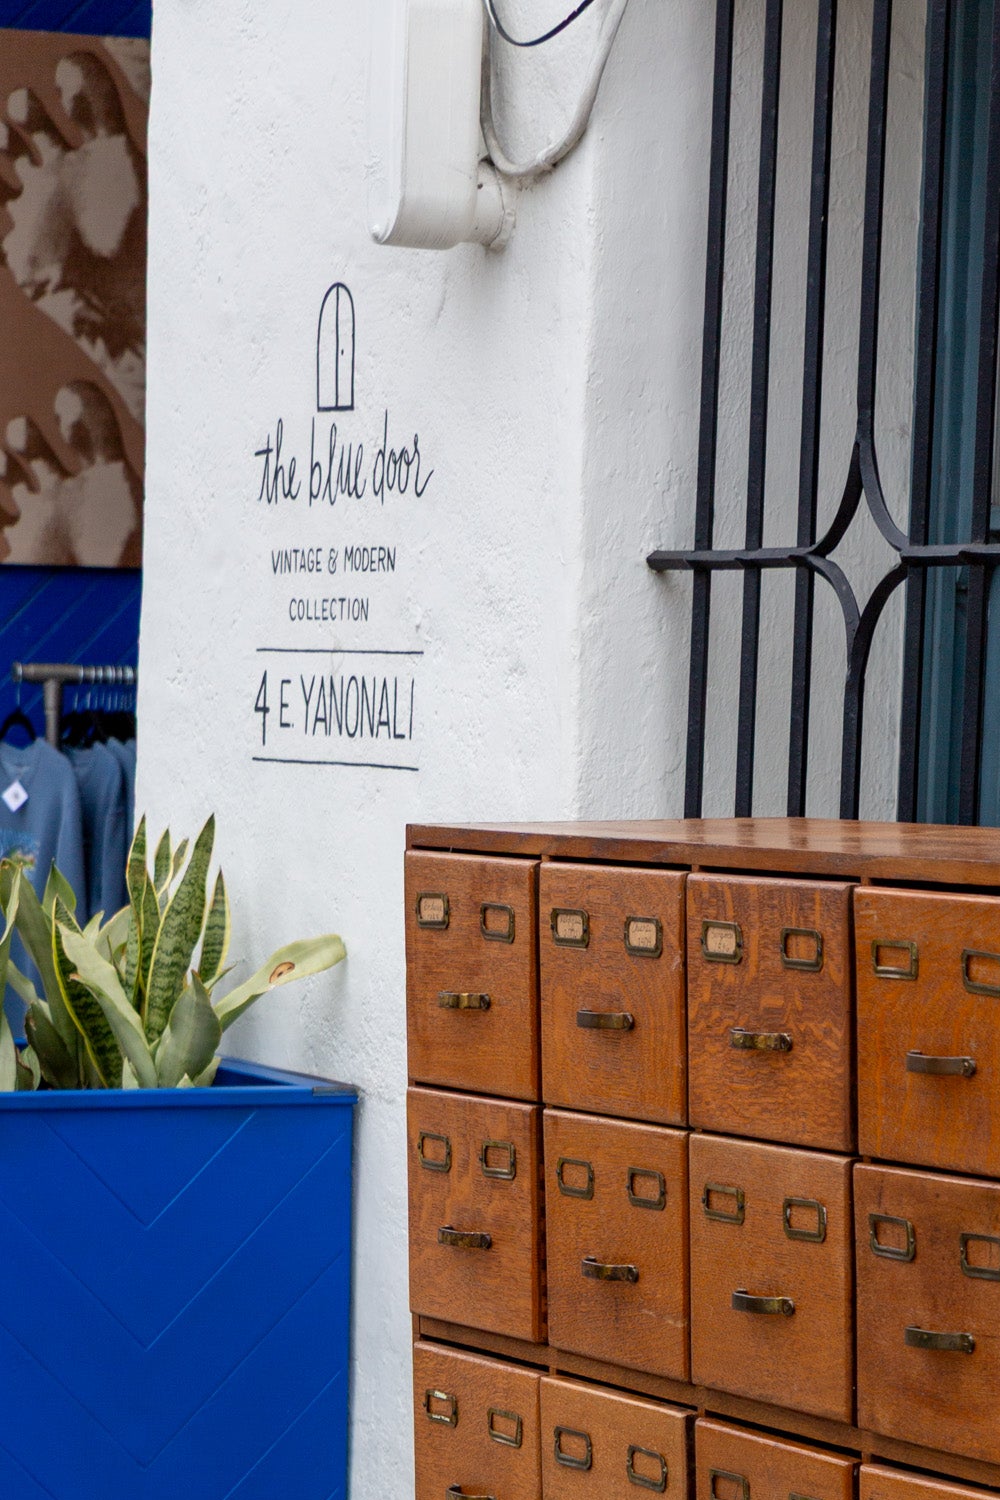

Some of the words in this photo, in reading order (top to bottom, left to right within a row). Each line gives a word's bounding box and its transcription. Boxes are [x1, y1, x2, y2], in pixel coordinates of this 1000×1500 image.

[254, 417, 302, 506] the
[308, 415, 367, 508] blue
[372, 408, 435, 507] door
[271, 547, 323, 575] VINTAGE
[327, 547, 339, 576] &
[343, 545, 397, 573] MODERN
[288, 597, 370, 622] COLLECTION
[254, 669, 271, 747] 4
[279, 678, 296, 729] E.
[300, 673, 415, 741] YANONALI
